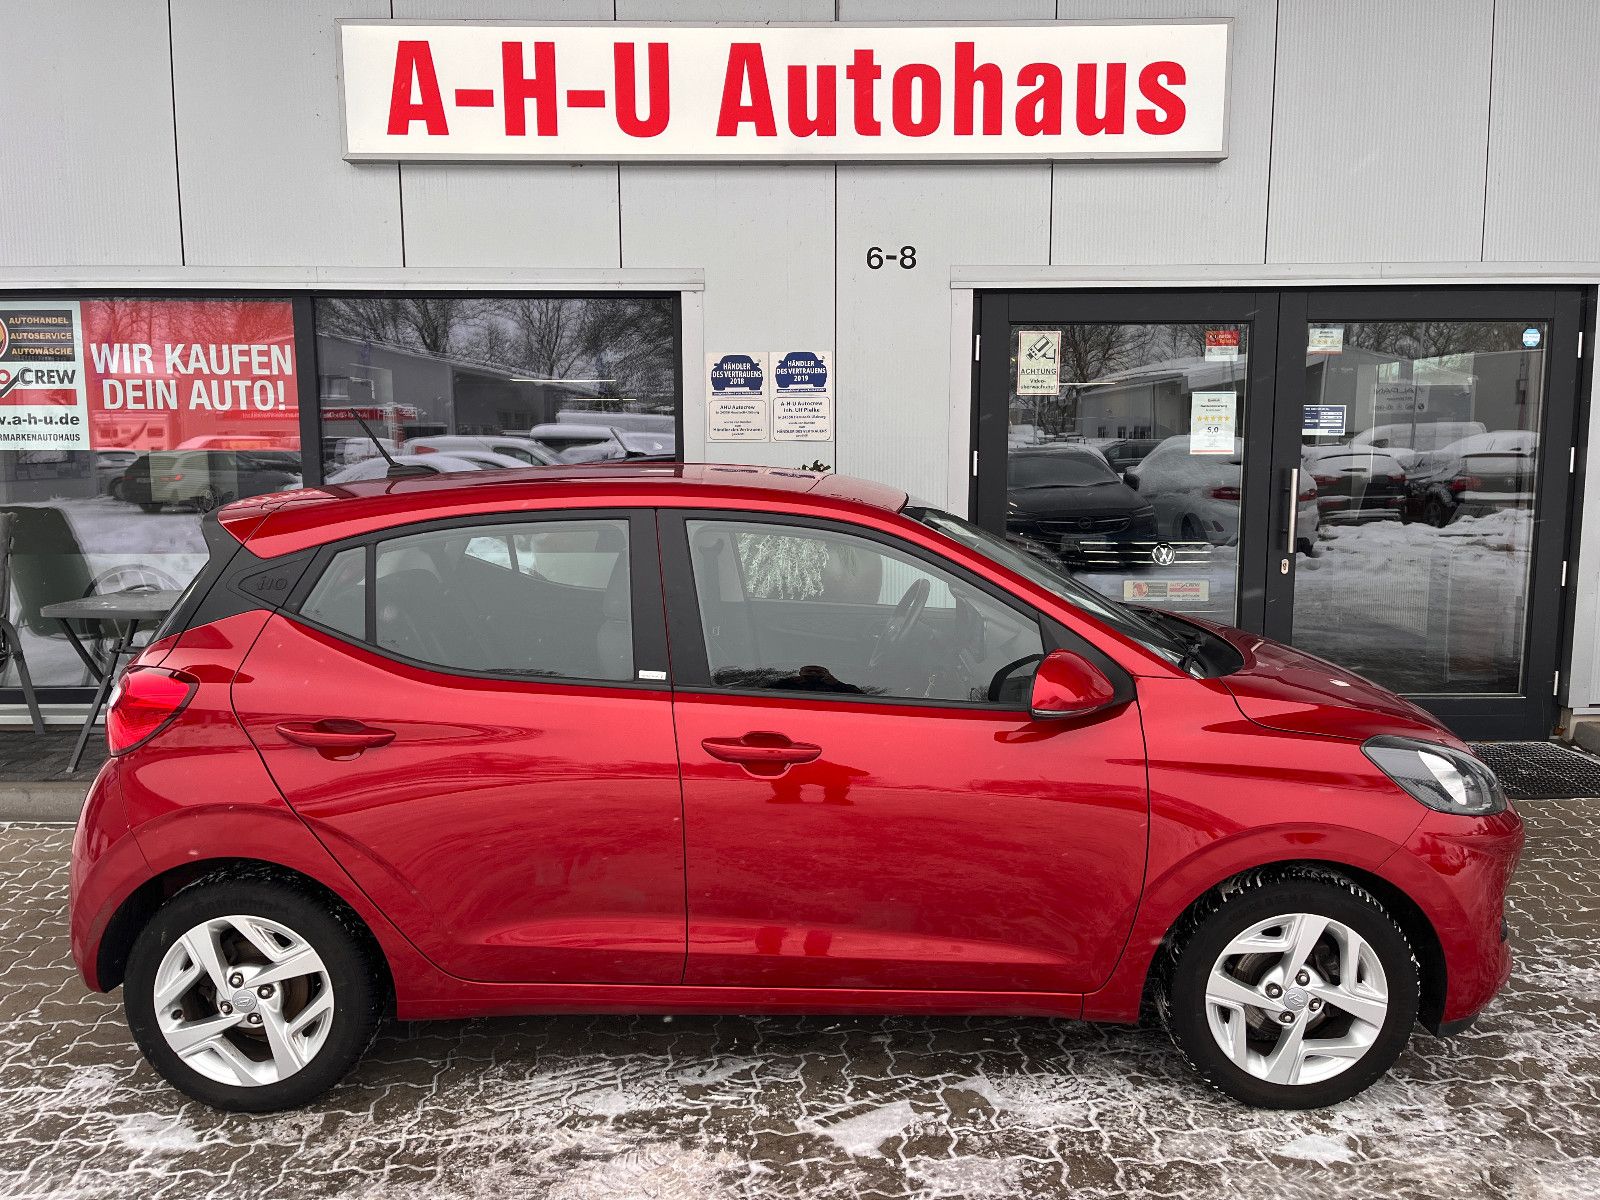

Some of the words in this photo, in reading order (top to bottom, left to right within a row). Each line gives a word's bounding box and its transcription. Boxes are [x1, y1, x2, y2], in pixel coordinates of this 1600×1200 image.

[387, 41, 669, 137] A-H-U
[717, 42, 1186, 137] Autohaus
[866, 245, 917, 269] 6-8
[10, 332, 72, 340] AUTOSERVICE
[12, 347, 73, 355] AUTOWÄSCHE
[90, 343, 154, 374] WIR
[165, 344, 292, 375] KAUFEN
[723, 362, 751, 370] HÄNDLER
[788, 367, 826, 375] VERTRAUENS
[103, 379, 178, 410] DEIN
[189, 380, 286, 411] AUTO!
